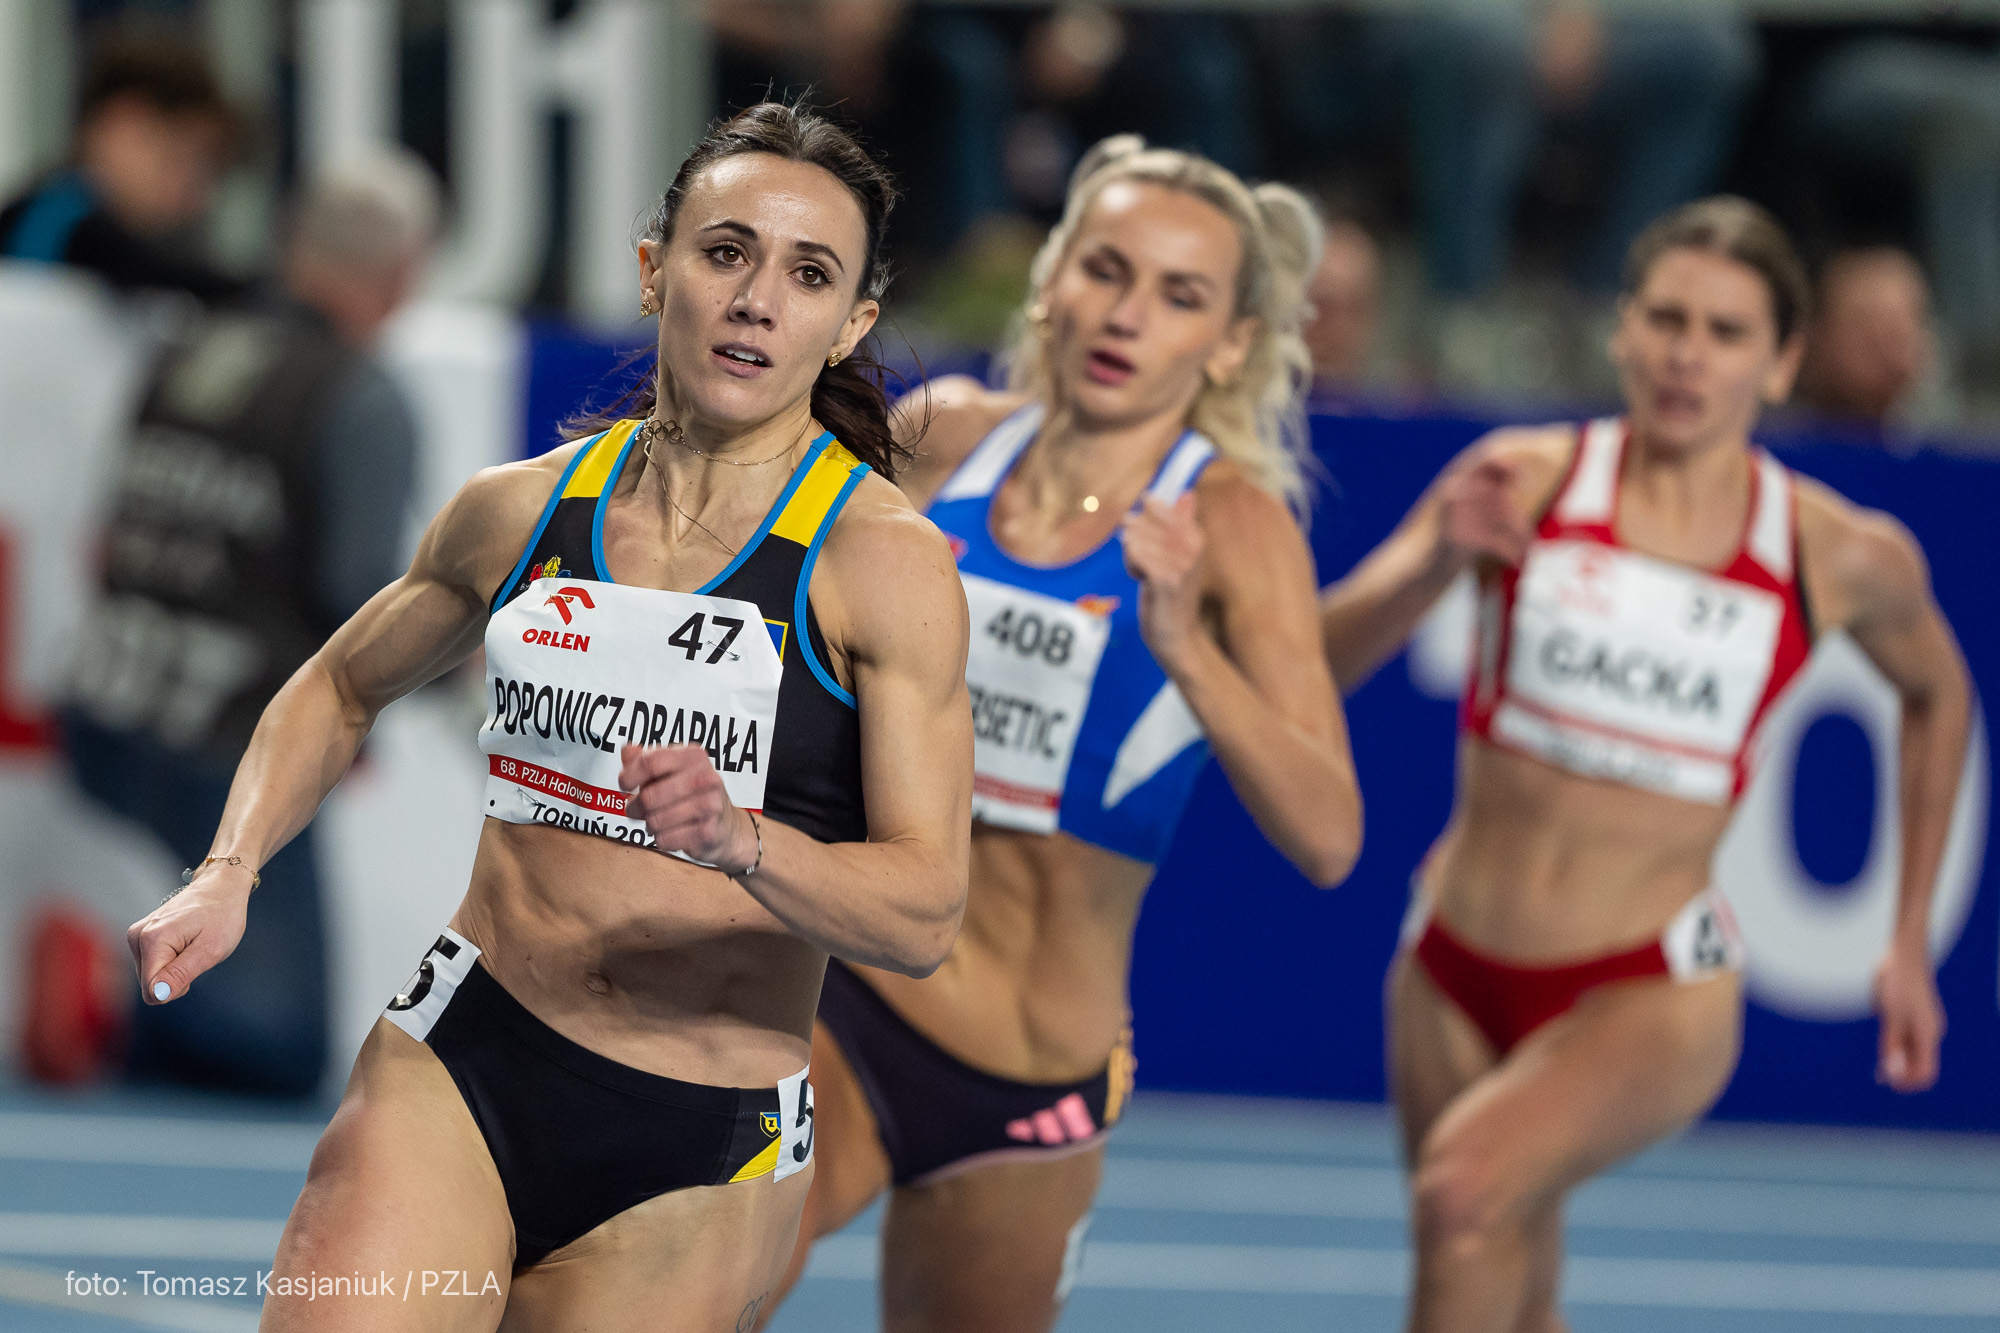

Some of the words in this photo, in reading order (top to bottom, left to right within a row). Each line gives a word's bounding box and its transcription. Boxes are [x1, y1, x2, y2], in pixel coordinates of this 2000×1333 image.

[522, 629, 590, 652] ORLEN
[668, 612, 745, 665] 47
[985, 606, 1075, 665] 408
[1542, 631, 1719, 719] GACKA
[490, 677, 758, 774] POPOWICZ-DRAPAŁA
[500, 759, 519, 778] 68.
[521, 766, 546, 788] PZLA
[548, 778, 593, 804] Halowe
[531, 801, 609, 837] TORUŃ
[386, 934, 461, 1011] 5
[792, 1075, 814, 1163] 5
